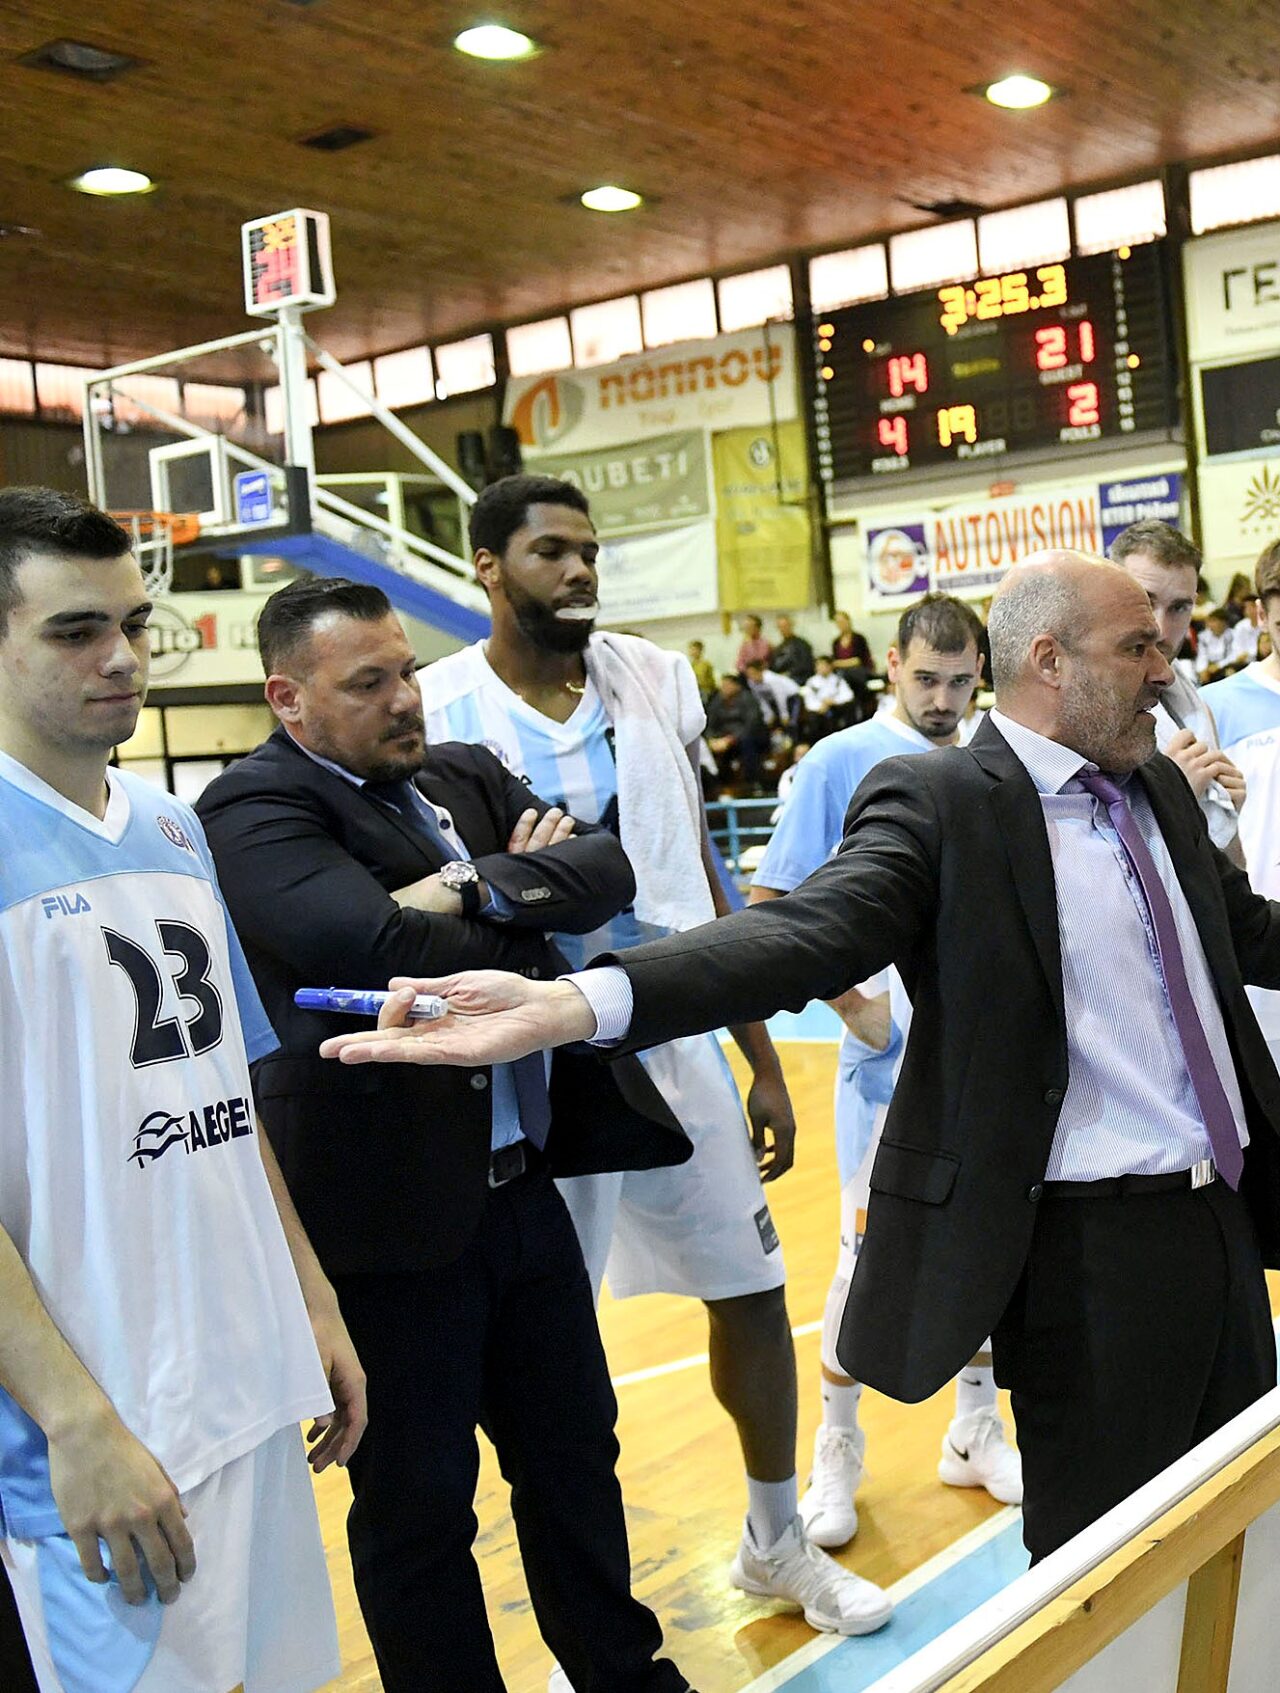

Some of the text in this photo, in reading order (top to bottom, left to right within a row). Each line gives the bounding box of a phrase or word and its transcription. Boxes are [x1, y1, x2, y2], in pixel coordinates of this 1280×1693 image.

[1035, 320, 1095, 370] 21
[887, 352, 928, 397] 14
[937, 404, 978, 447] 19
[1067, 382, 1100, 427] 2
[878, 416, 909, 456] 4
[934, 495, 1098, 573] AUTOVISION
[42, 892, 92, 919] FILA
[100, 918, 225, 1069] 23
